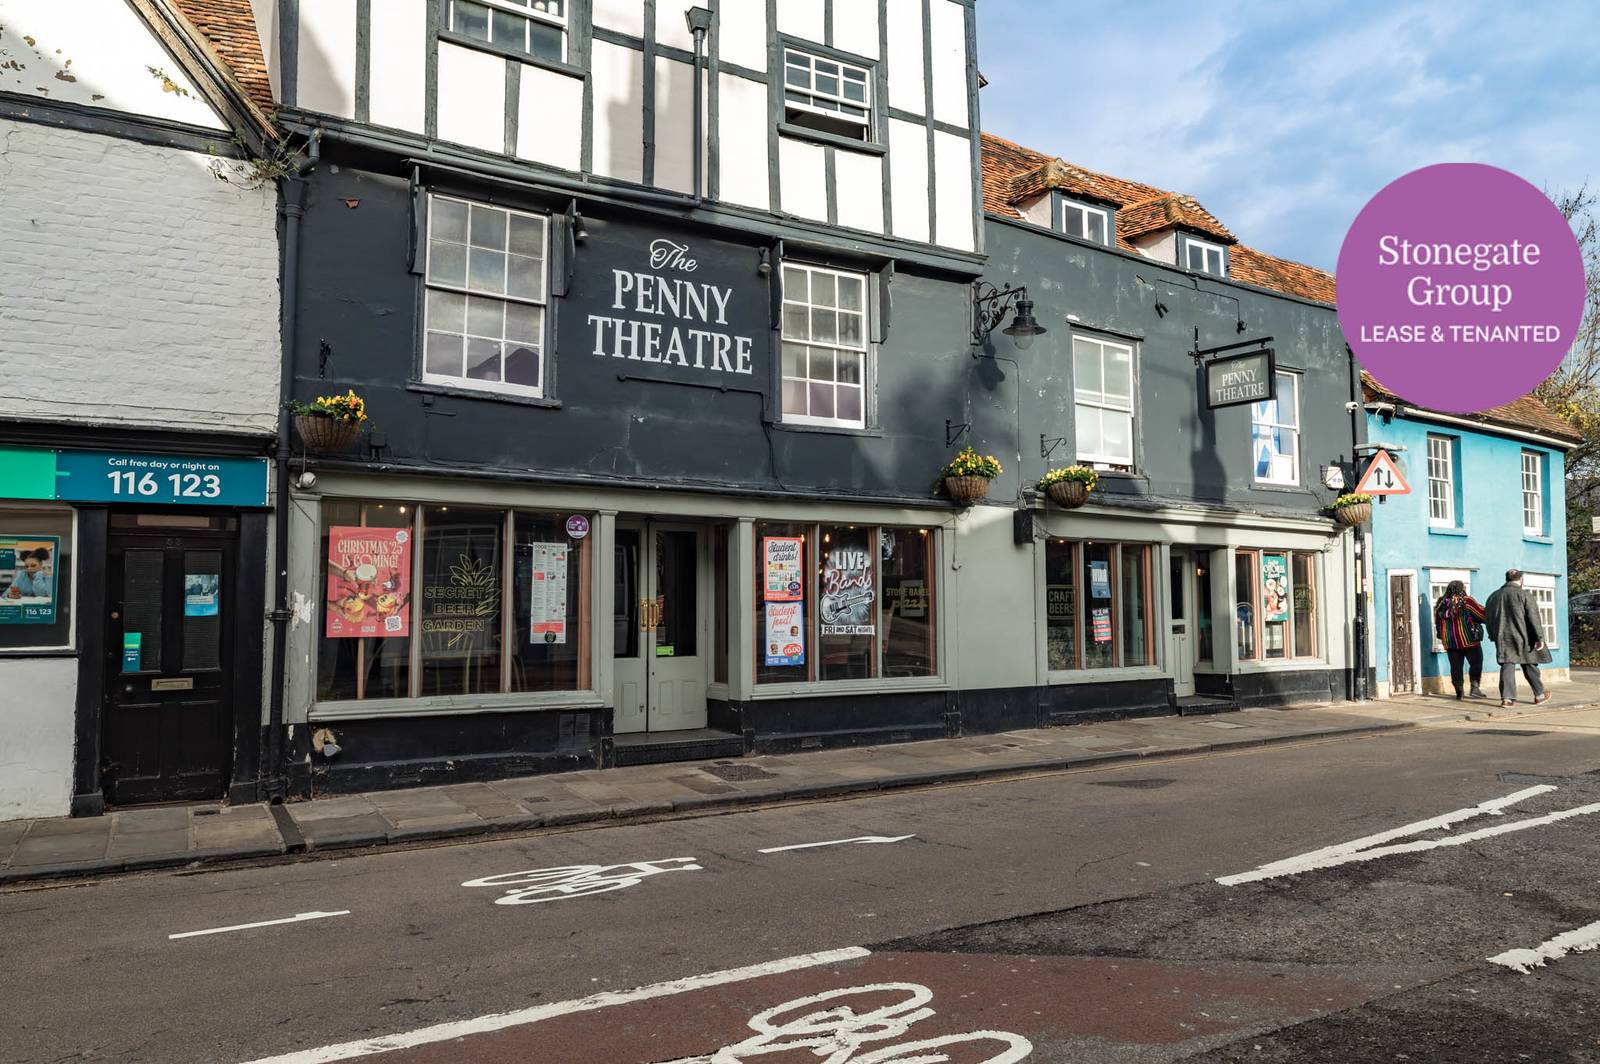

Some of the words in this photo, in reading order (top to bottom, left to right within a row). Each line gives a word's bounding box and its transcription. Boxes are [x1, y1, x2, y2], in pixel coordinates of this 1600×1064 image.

[649, 238, 698, 272] The
[611, 268, 732, 325] PENNY
[587, 314, 753, 375] THEATRE
[1221, 368, 1257, 387] PENNY
[1215, 382, 1265, 402] THEATRE
[108, 458, 127, 466] Call
[129, 459, 148, 467] free
[149, 460, 168, 470] day
[182, 462, 206, 471] night
[107, 470, 159, 496] 116
[167, 473, 221, 498] 123
[337, 539, 388, 554] CHRISTMAS
[768, 541, 797, 553] Student
[342, 554, 351, 567] IS
[353, 554, 398, 568] COMING!
[835, 551, 864, 570] LIVE
[824, 566, 872, 597] Bands
[424, 586, 484, 599] SECRET
[1048, 591, 1073, 602] CRAFT
[433, 602, 475, 615] BEER
[768, 605, 796, 616] Student
[1048, 603, 1073, 614] BEERS
[422, 619, 485, 632] GARDEN
[824, 626, 836, 634] FRI
[845, 626, 857, 634] SAT
